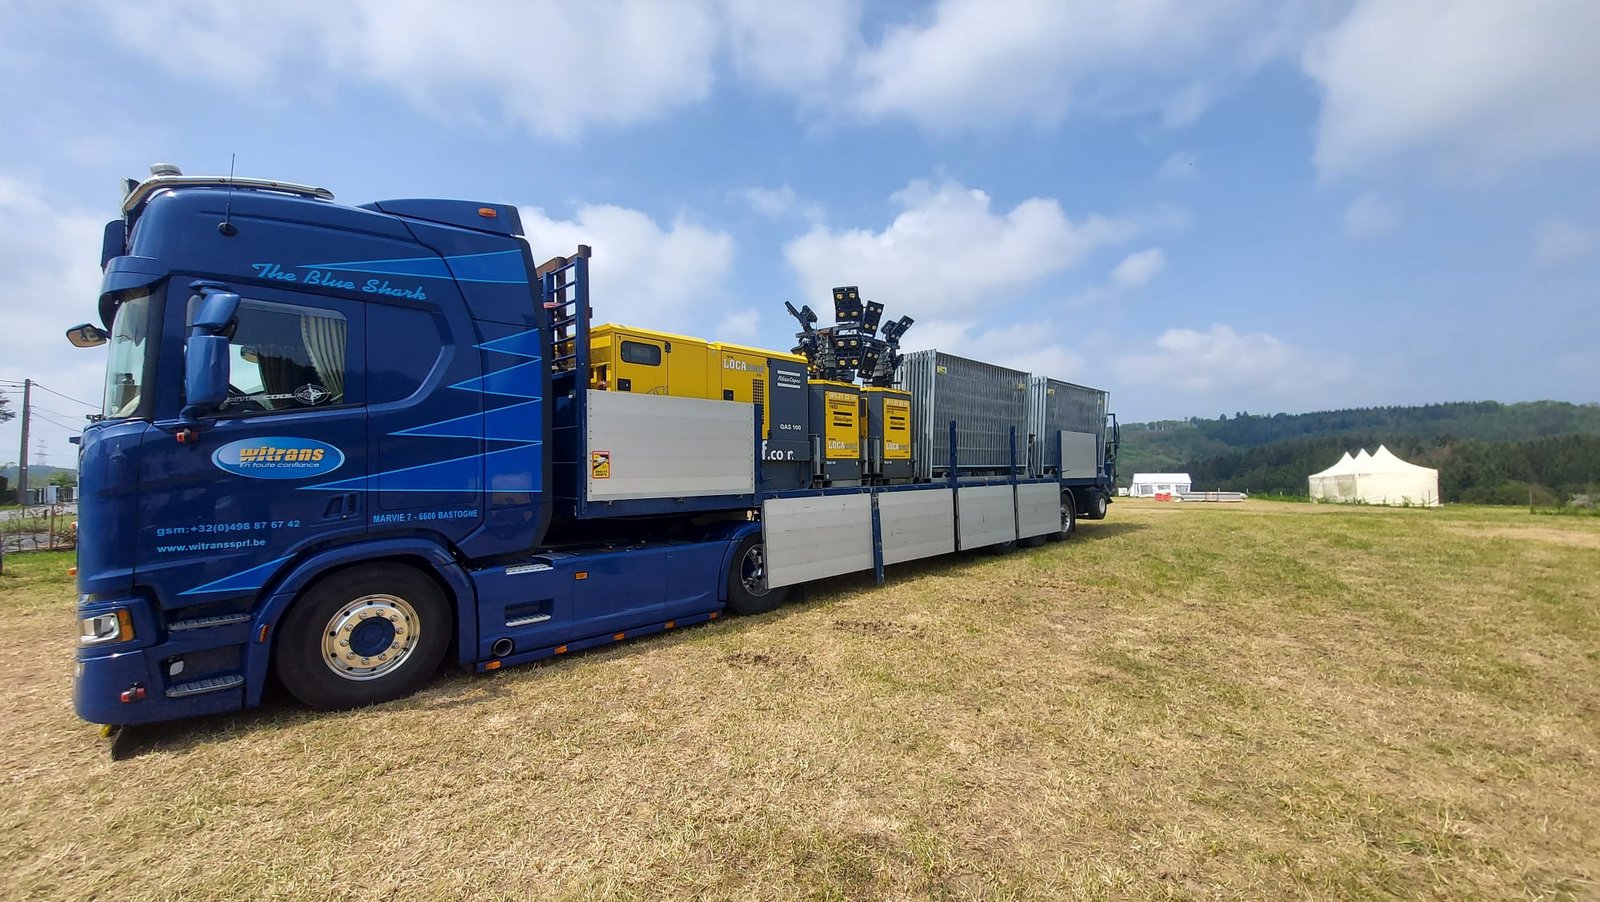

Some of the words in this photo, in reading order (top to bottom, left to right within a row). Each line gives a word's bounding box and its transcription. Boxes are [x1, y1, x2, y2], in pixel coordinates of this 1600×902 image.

[252, 263, 297, 282] The
[303, 270, 356, 290] Blue
[362, 279, 428, 300] Shark
[240, 446, 325, 463] witrans
[373, 513, 405, 523] MARVIE
[406, 513, 412, 521] 7
[418, 512, 436, 520] 6600
[437, 509, 478, 519] BASTOGNE
[253, 521, 268, 530] 87
[270, 520, 284, 529] 67
[287, 519, 301, 528] 42
[156, 538, 266, 553] www.witranssprl.be
